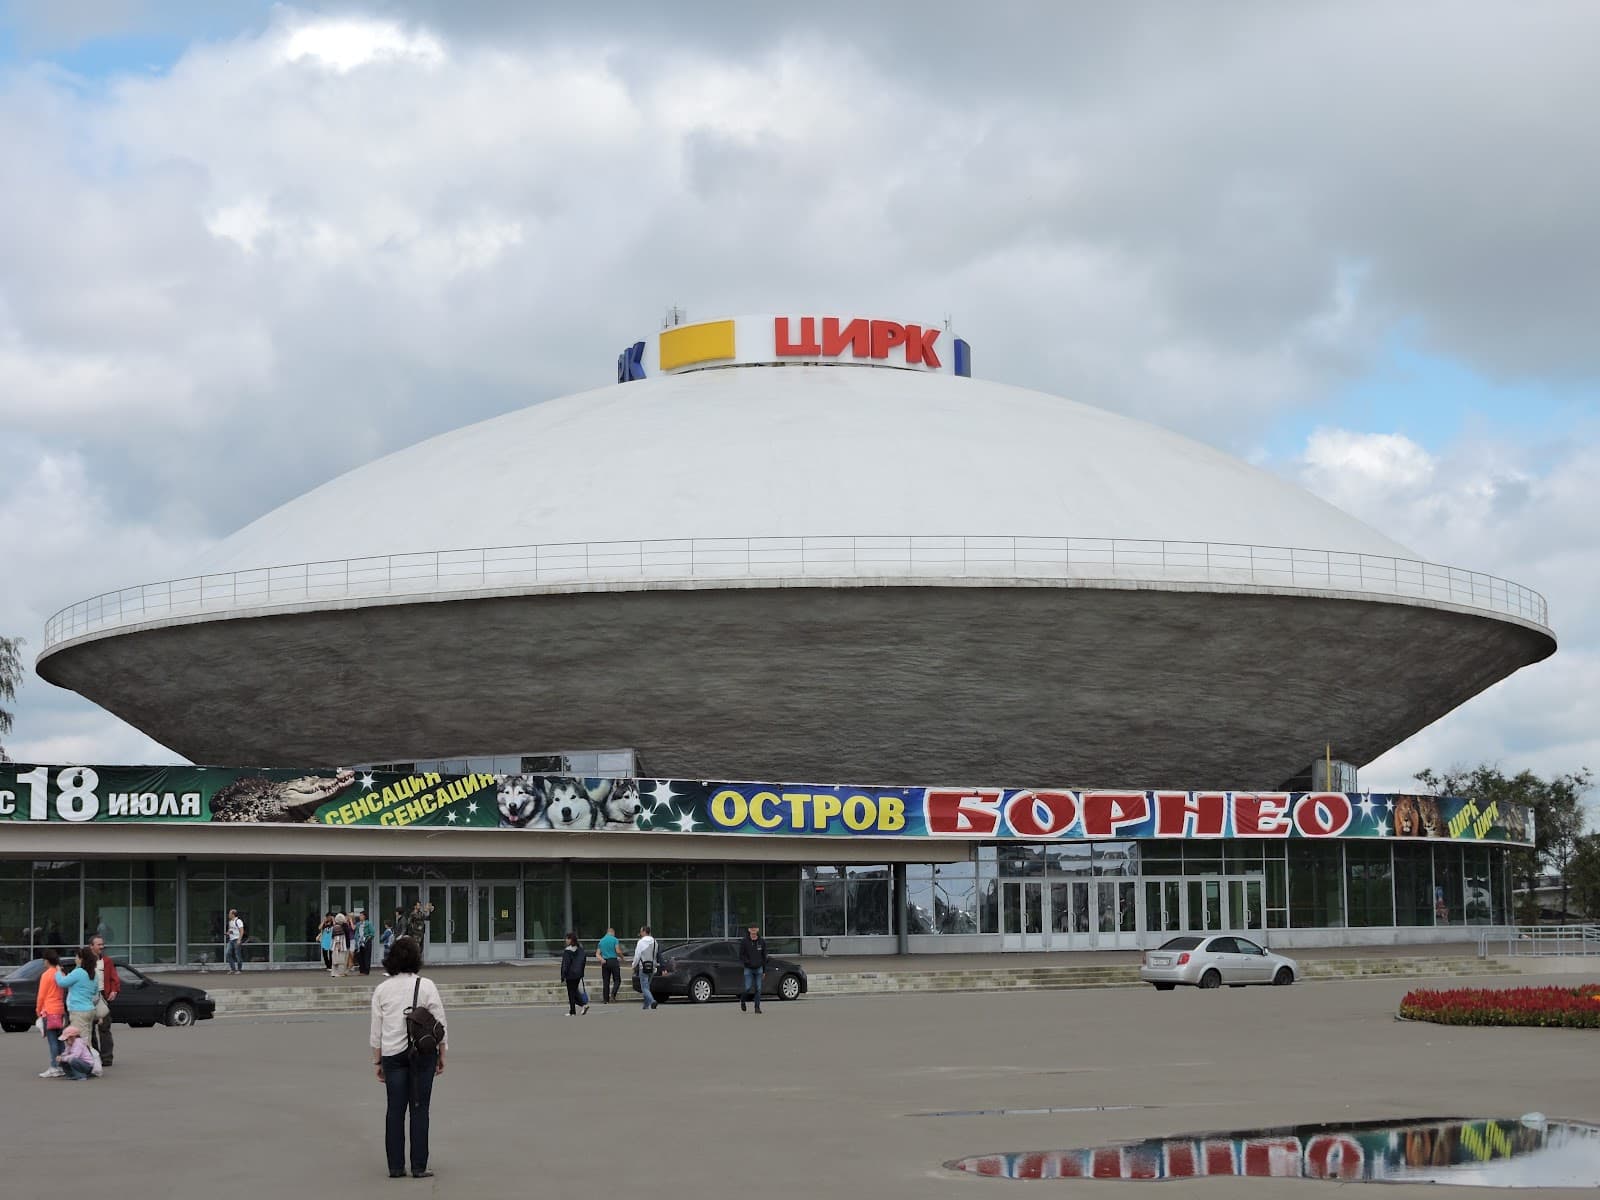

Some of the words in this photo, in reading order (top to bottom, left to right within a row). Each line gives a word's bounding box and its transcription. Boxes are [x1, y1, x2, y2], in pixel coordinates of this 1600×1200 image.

[774, 316, 942, 369] ЦИРК
[16, 766, 99, 821] 18
[325, 772, 441, 825] СЕНСАЦИЯ
[380, 773, 495, 826] СЕНСАЦИЯ
[710, 790, 906, 831] ОСТРОВ
[923, 788, 1352, 838] БОРНЕО
[1448, 798, 1480, 839] ЦИРК
[1473, 800, 1500, 840] ЦИРК
